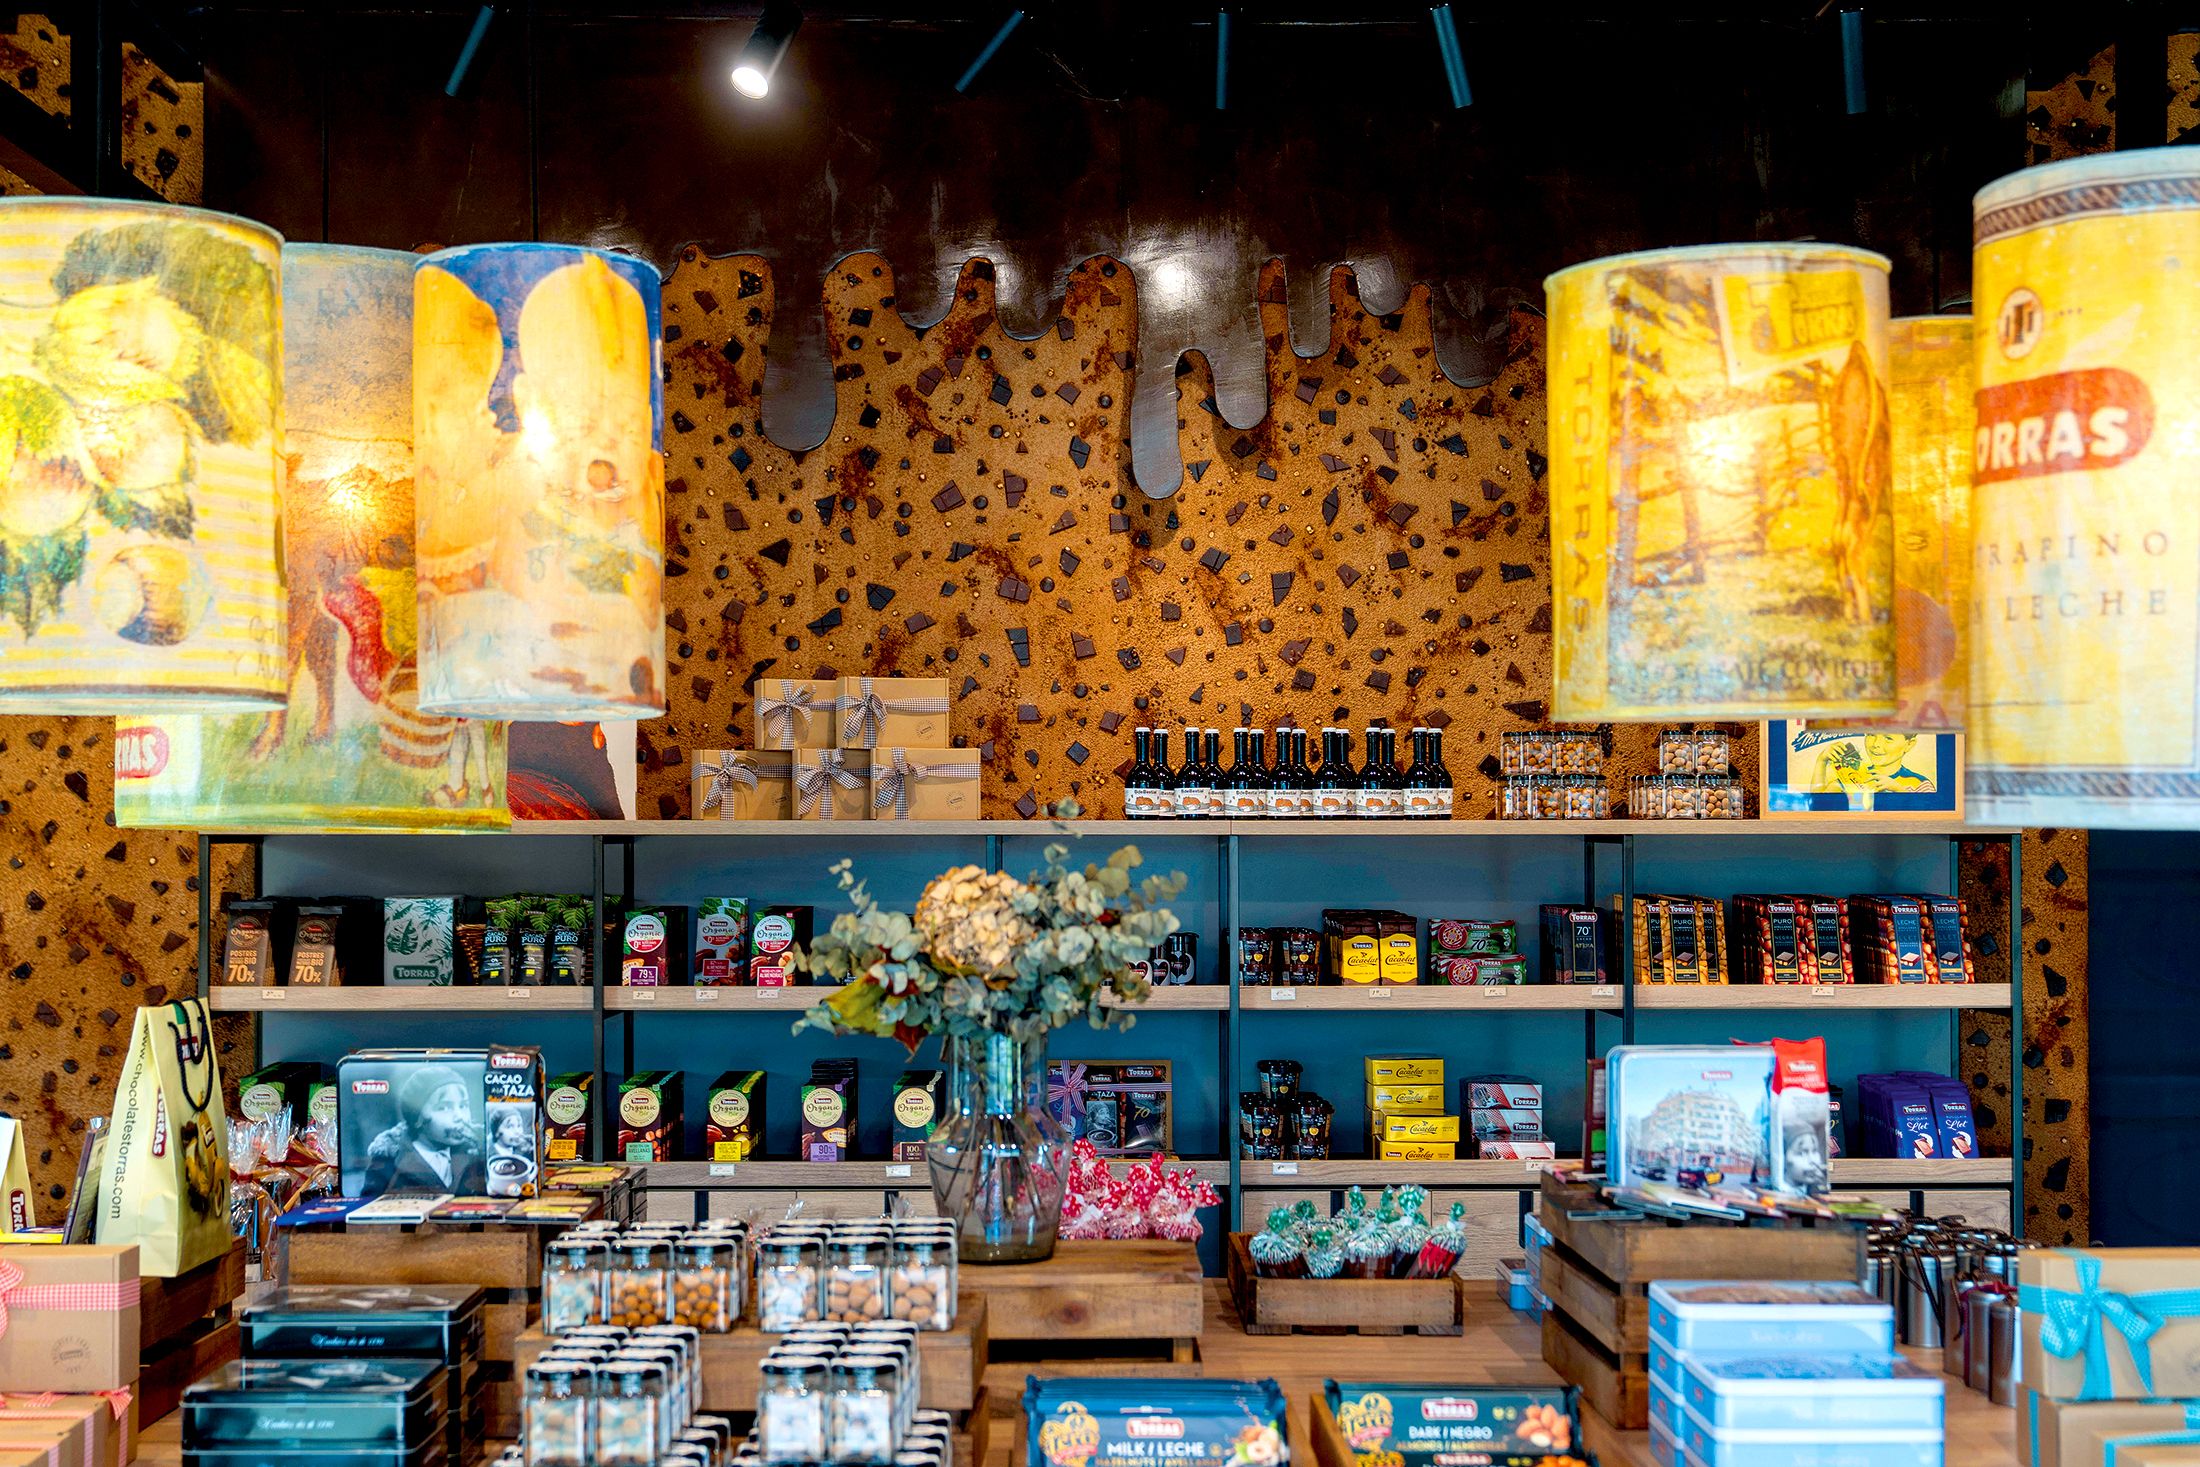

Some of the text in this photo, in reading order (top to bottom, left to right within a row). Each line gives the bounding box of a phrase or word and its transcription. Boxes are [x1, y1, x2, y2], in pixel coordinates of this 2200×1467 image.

[756, 930, 790, 939] Organic
[228, 964, 256, 982] 70%
[295, 966, 322, 983] 70%
[396, 967, 436, 978] TORRAS
[494, 1056, 527, 1066] TORRAS
[484, 1074, 522, 1084] CACAO
[503, 1084, 535, 1096] TAZA
[550, 1100, 582, 1110] Organic
[624, 1103, 656, 1112] Organic
[712, 1104, 746, 1113] Organic
[806, 1103, 840, 1111] Organic
[898, 1103, 930, 1113] Organic
[1906, 1122, 1930, 1133] Llet
[1946, 1119, 1968, 1131] Llet
[1425, 1402, 1473, 1418] TORRAS
[1131, 1420, 1180, 1436] TORRAS
[1408, 1426, 1441, 1439] DARK
[1449, 1426, 1493, 1439] NEGRO
[1107, 1442, 1145, 1456] MILK
[1157, 1442, 1204, 1456] LECHE
